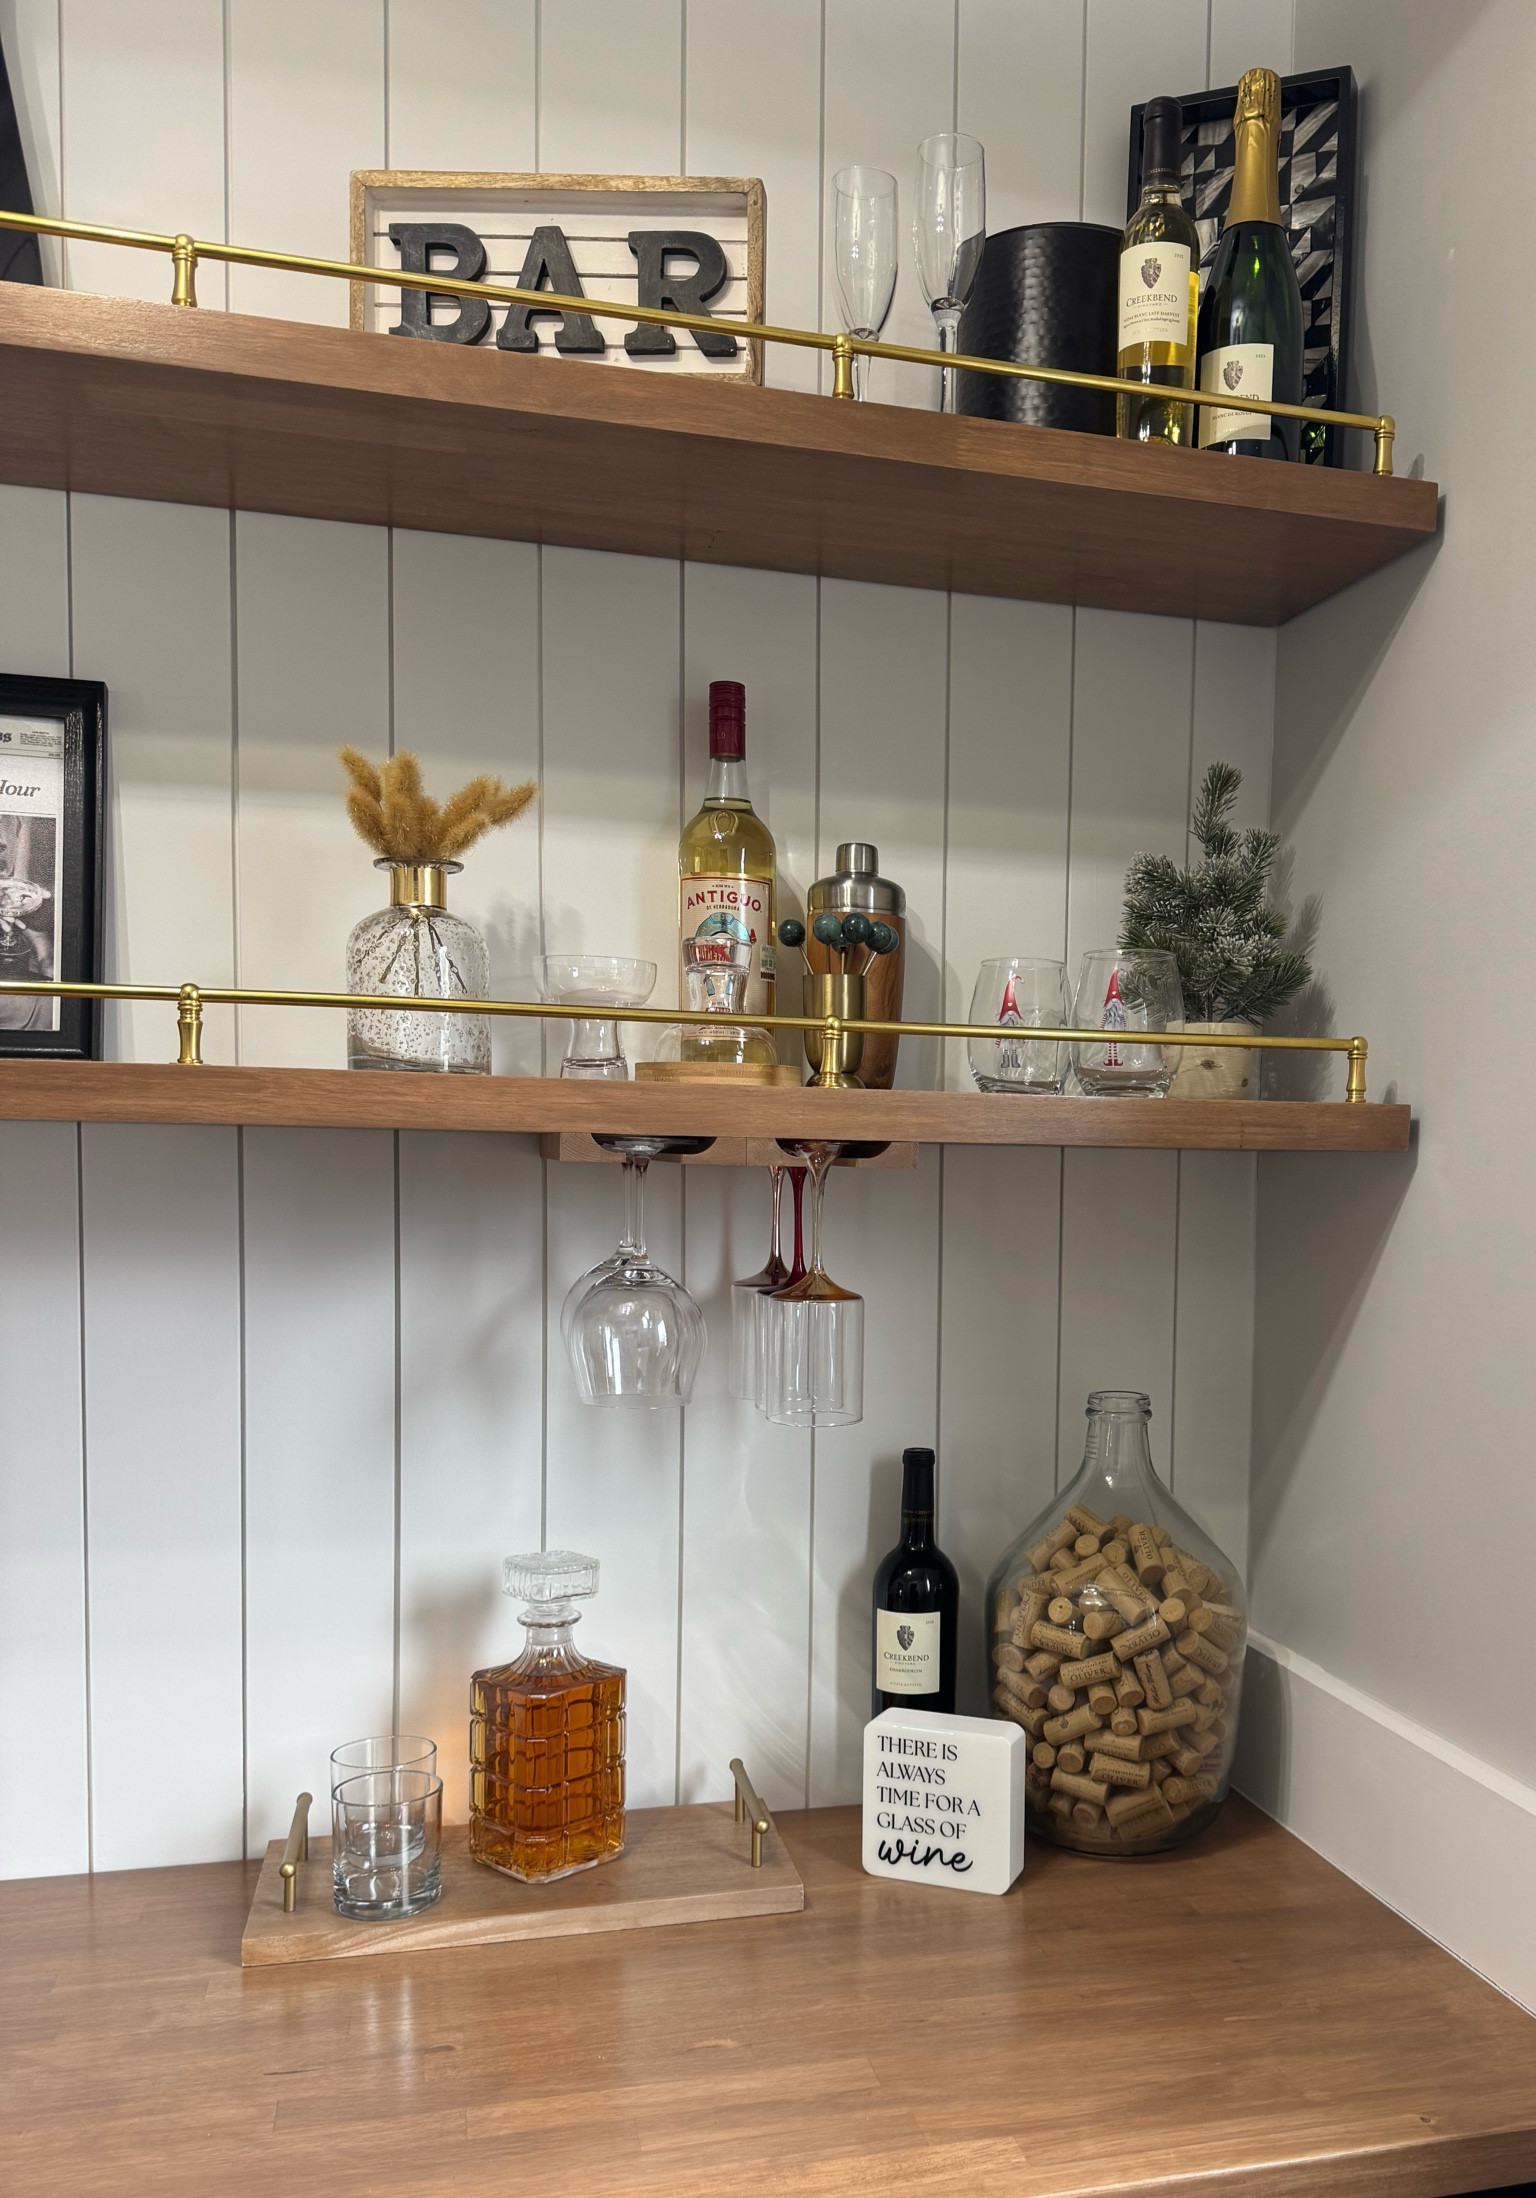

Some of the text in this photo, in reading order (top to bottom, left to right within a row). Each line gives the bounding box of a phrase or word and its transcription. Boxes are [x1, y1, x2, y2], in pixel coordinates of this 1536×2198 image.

[389, 223, 737, 357] BAR
[1126, 294, 1178, 307] CREEKBEND
[687, 890, 761, 912] ANTIGUO
[1138, 1530, 1154, 1560] OLIVER
[1120, 1629, 1160, 1652] OLIVER
[883, 1651, 930, 1662] CREEKBEND
[1070, 1667, 1112, 1682] OLIVER
[877, 1735, 958, 1762] THERE IS
[876, 1761, 946, 1785] ALWAYS
[1101, 1773, 1139, 1786] OLIVER
[876, 1786, 981, 1817] TIME FOR A
[876, 1812, 967, 1839] GLASS OF
[878, 1839, 973, 1872] wine
